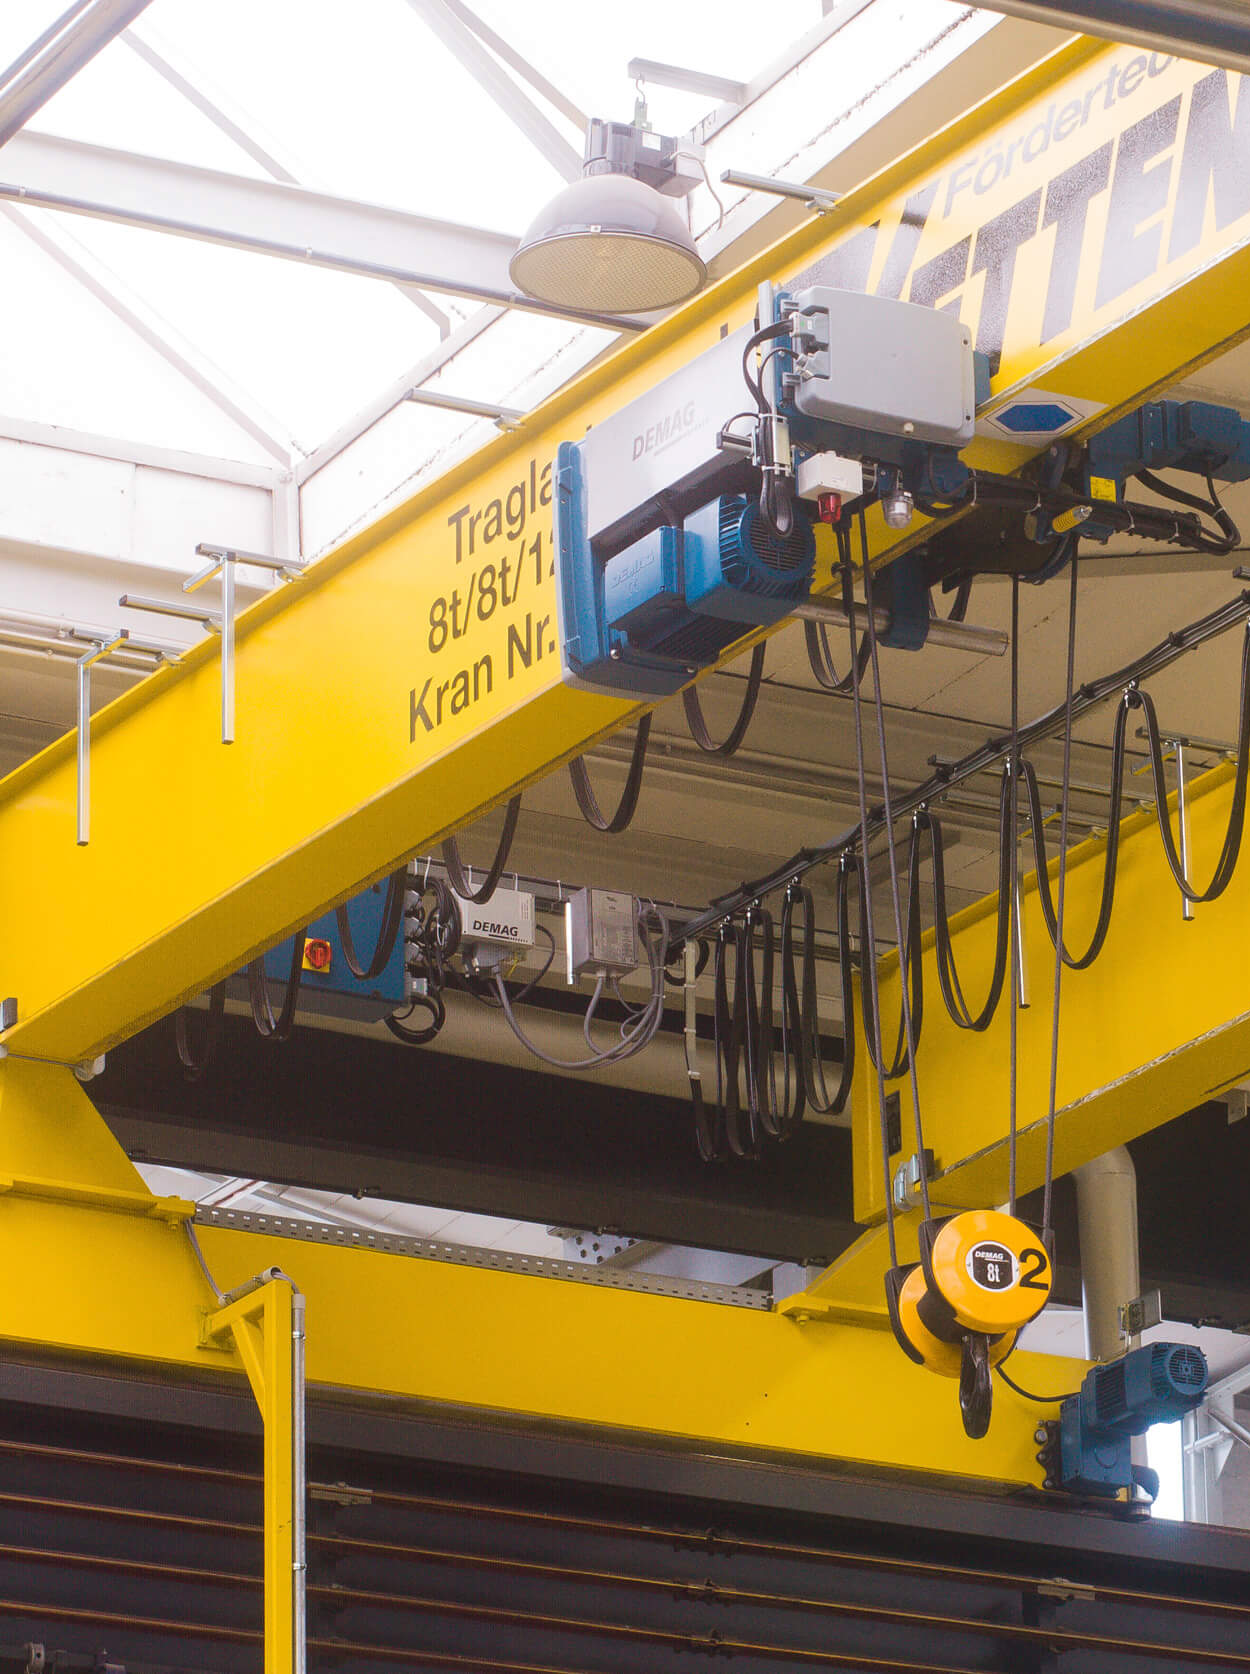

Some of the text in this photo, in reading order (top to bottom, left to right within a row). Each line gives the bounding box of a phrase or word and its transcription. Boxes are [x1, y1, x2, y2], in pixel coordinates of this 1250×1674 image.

[632, 401, 696, 462] DEMAG
[428, 528, 555, 654] 8t/8t/1
[409, 612, 555, 744] Kran Nr.
[472, 919, 519, 937] DEMAG
[975, 1250, 1004, 1260] DEMAG
[986, 1262, 1001, 1283] 8t
[1018, 1248, 1049, 1291] 2
